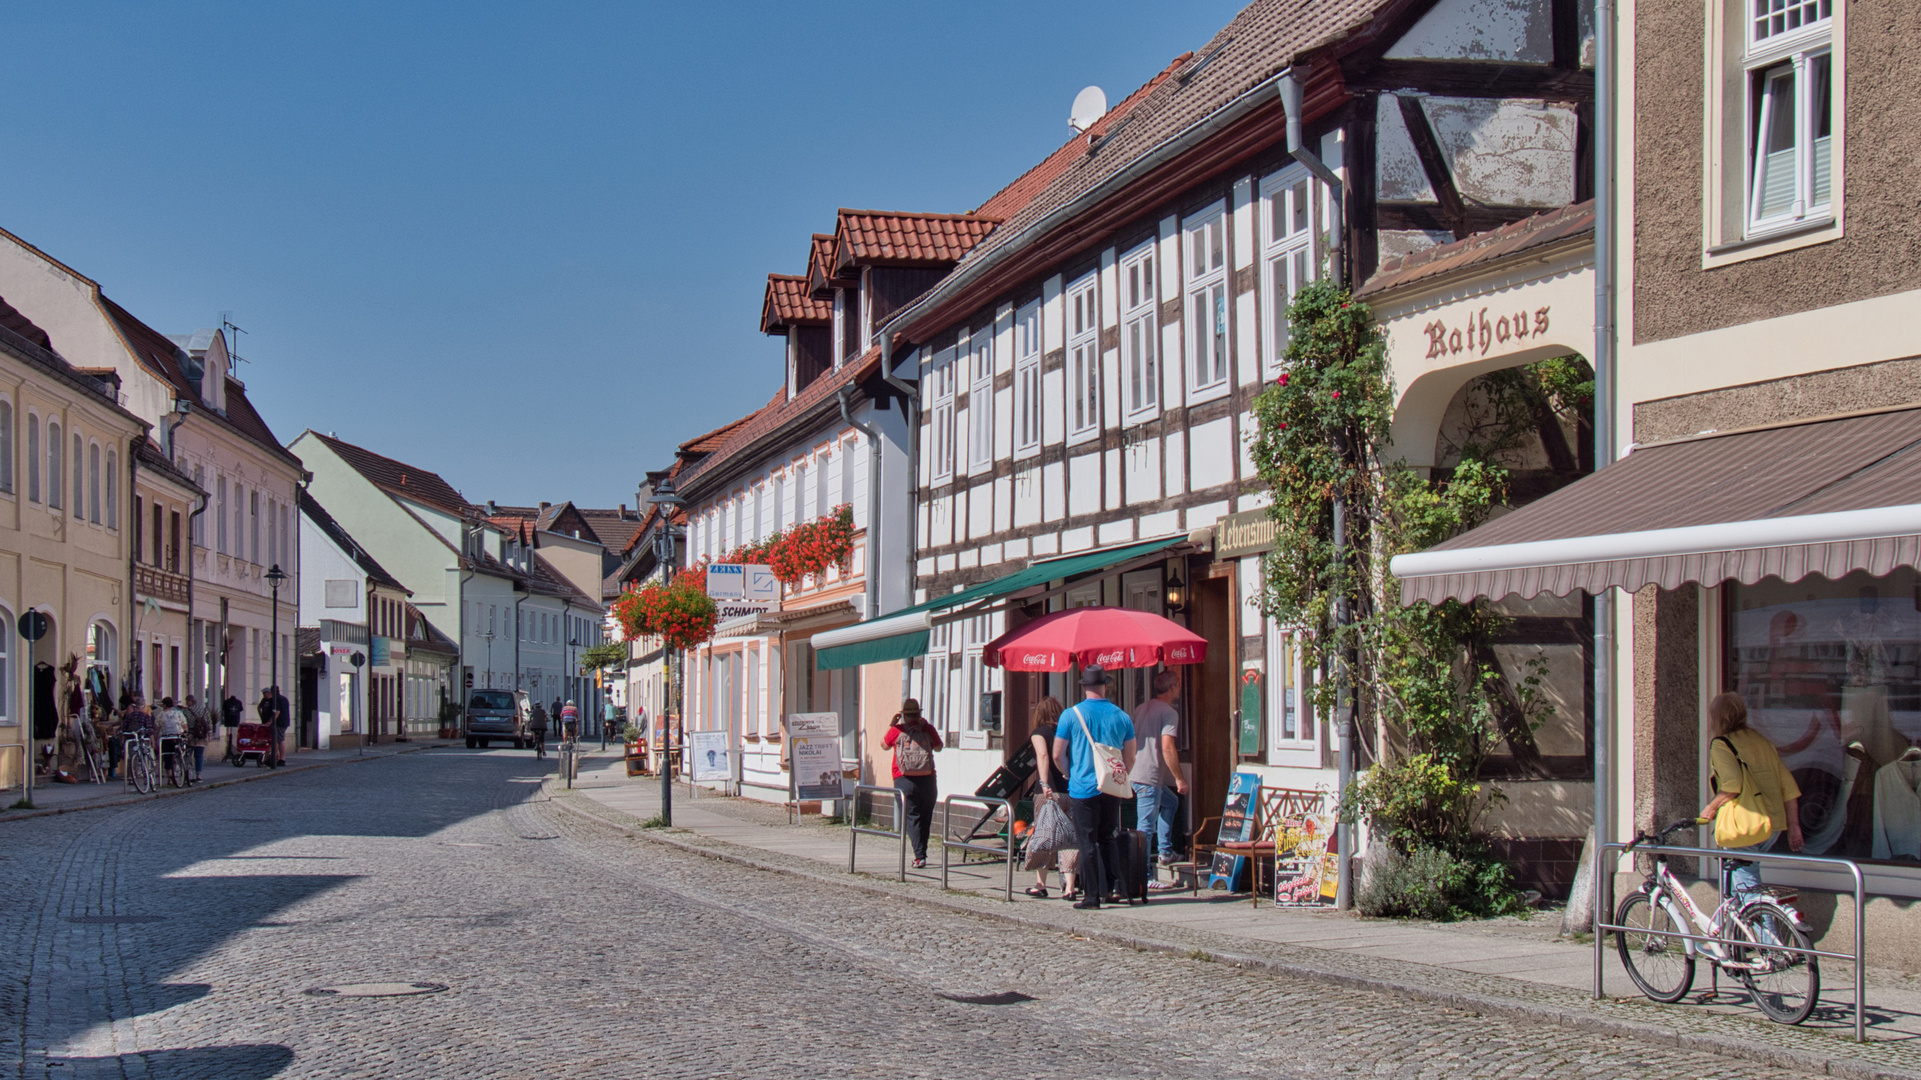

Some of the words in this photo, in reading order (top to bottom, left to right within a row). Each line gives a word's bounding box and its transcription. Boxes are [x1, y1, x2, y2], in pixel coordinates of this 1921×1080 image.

[1424, 305, 1551, 360] Rathaus
[710, 565, 742, 574] ZEISS
[709, 590, 742, 598] Germany
[722, 606, 769, 617] SCHMIDT
[1277, 872, 1309, 894] täglich
[1293, 879, 1318, 903] frisch
